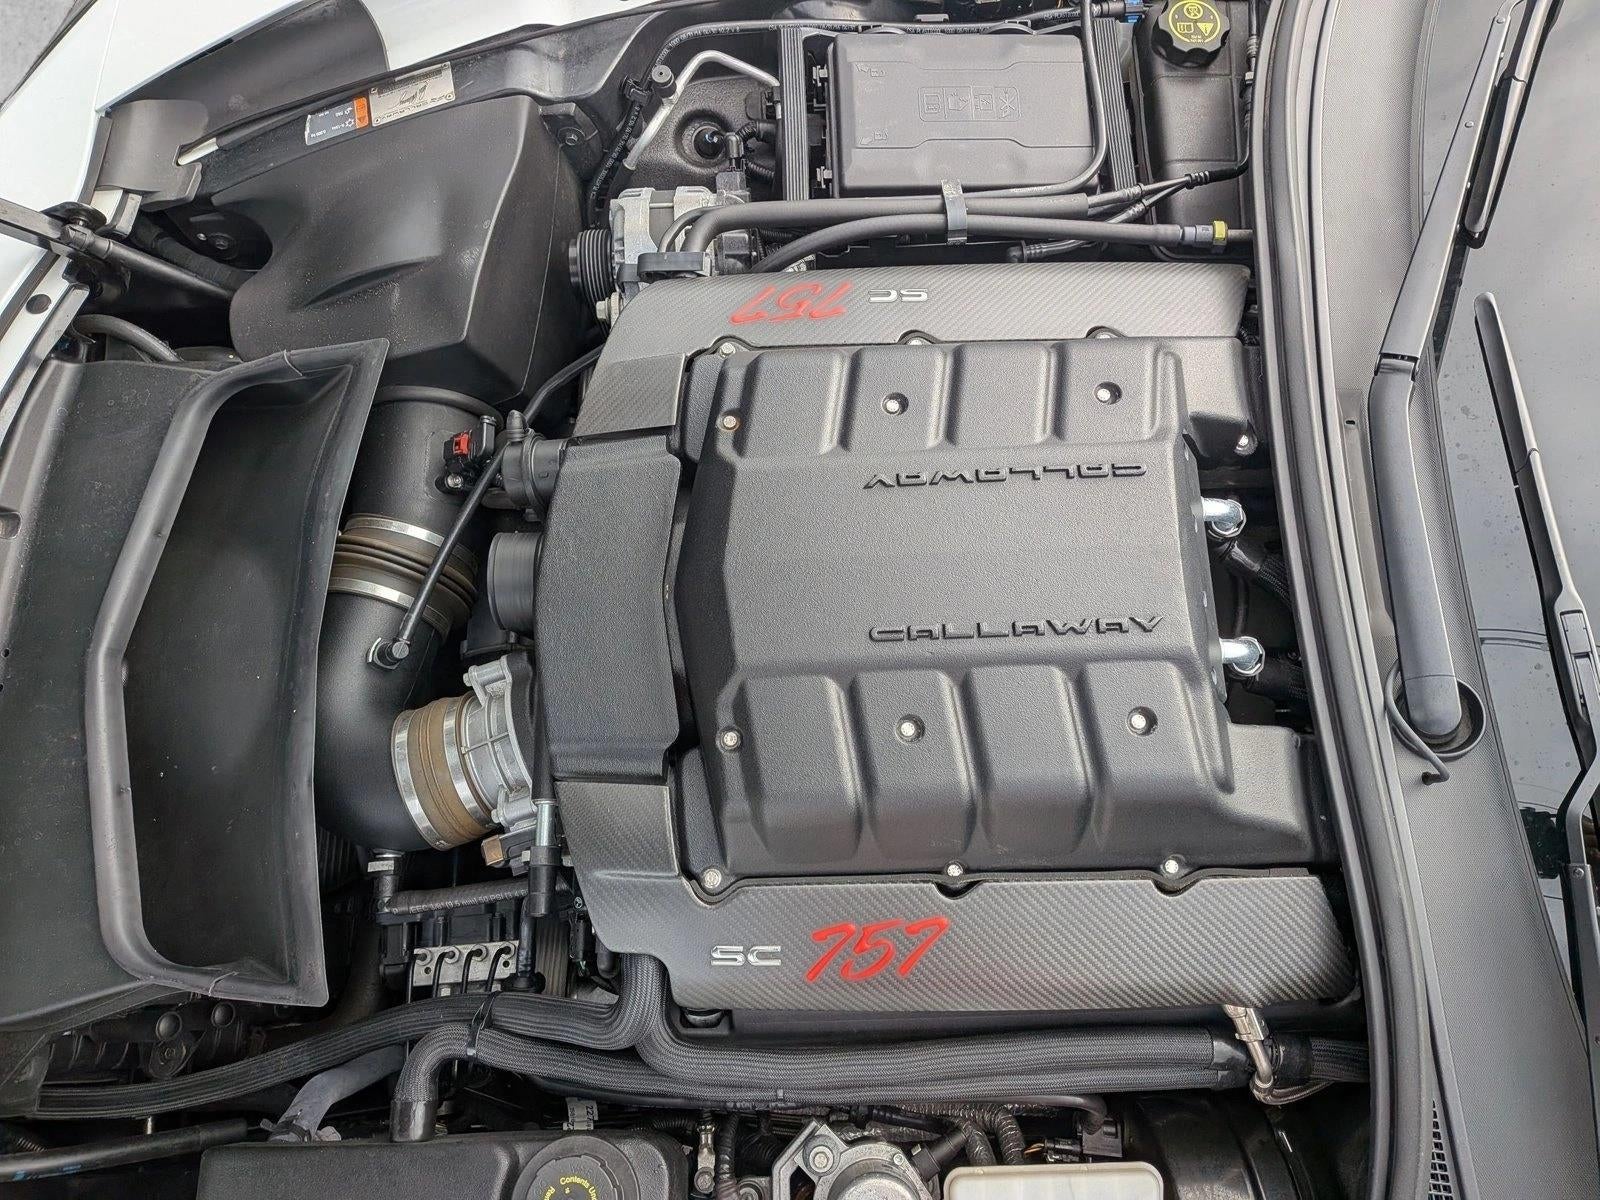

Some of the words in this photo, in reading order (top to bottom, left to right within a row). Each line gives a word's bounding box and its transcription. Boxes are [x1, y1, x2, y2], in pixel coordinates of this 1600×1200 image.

[730, 281, 853, 325] 757
[868, 288, 928, 303] SC
[863, 462, 1148, 490] CALLAWAY
[869, 616, 1163, 642] CALLAWAY
[711, 945, 781, 966] SC
[806, 916, 949, 983] 757
[559, 1175, 590, 1189] Contents
